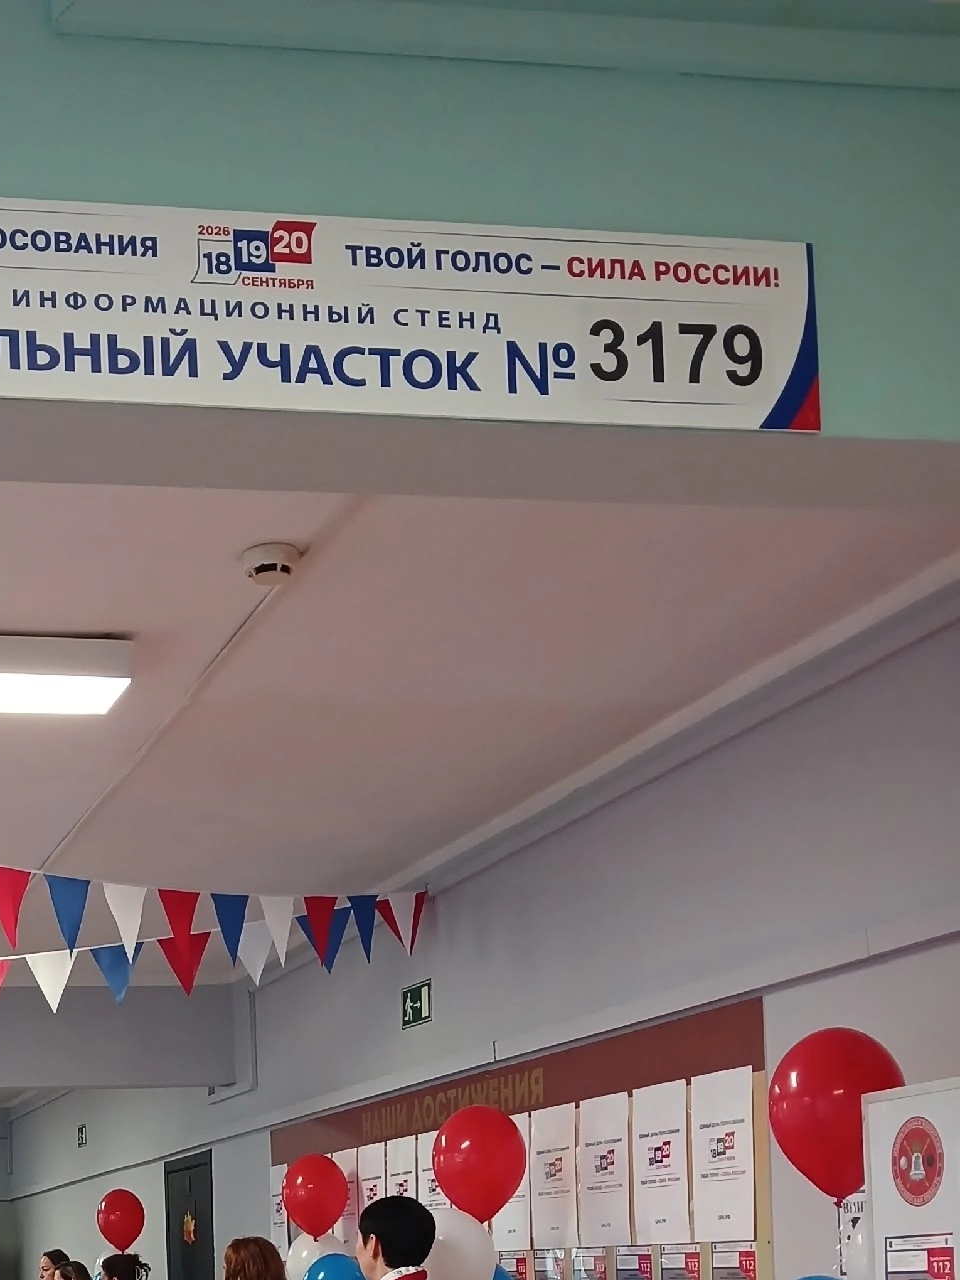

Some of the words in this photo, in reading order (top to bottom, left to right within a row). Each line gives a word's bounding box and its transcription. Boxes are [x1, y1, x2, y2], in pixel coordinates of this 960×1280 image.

[197, 225, 231, 236] 2026
[203, 252, 233, 275] 18
[237, 240, 267, 264] 19
[273, 230, 309, 254] 20
[345, 242, 426, 270] ТВОЙ
[435, 249, 533, 275] ГОЛОС
[566, 256, 647, 281] СИЛА
[654, 260, 781, 288] РОССИИ!
[241, 276, 315, 290] СЕНТЯБРЯ
[12, 289, 376, 325] ИНФОРМАЦИОННЫЙ
[392, 308, 502, 334] СТЕНД
[216, 340, 482, 392] УЧАСТОК
[506, 340, 576, 396] №
[589, 318, 763, 387] 3179
[362, 1103, 408, 1141] НАШИ
[411, 1067, 545, 1133] ДОСТИЖЕНИЯ
[640, 1263, 651, 1272] 112
[687, 1262, 699, 1271] 112
[741, 1260, 755, 1270] 112
[932, 1261, 951, 1273] 112
